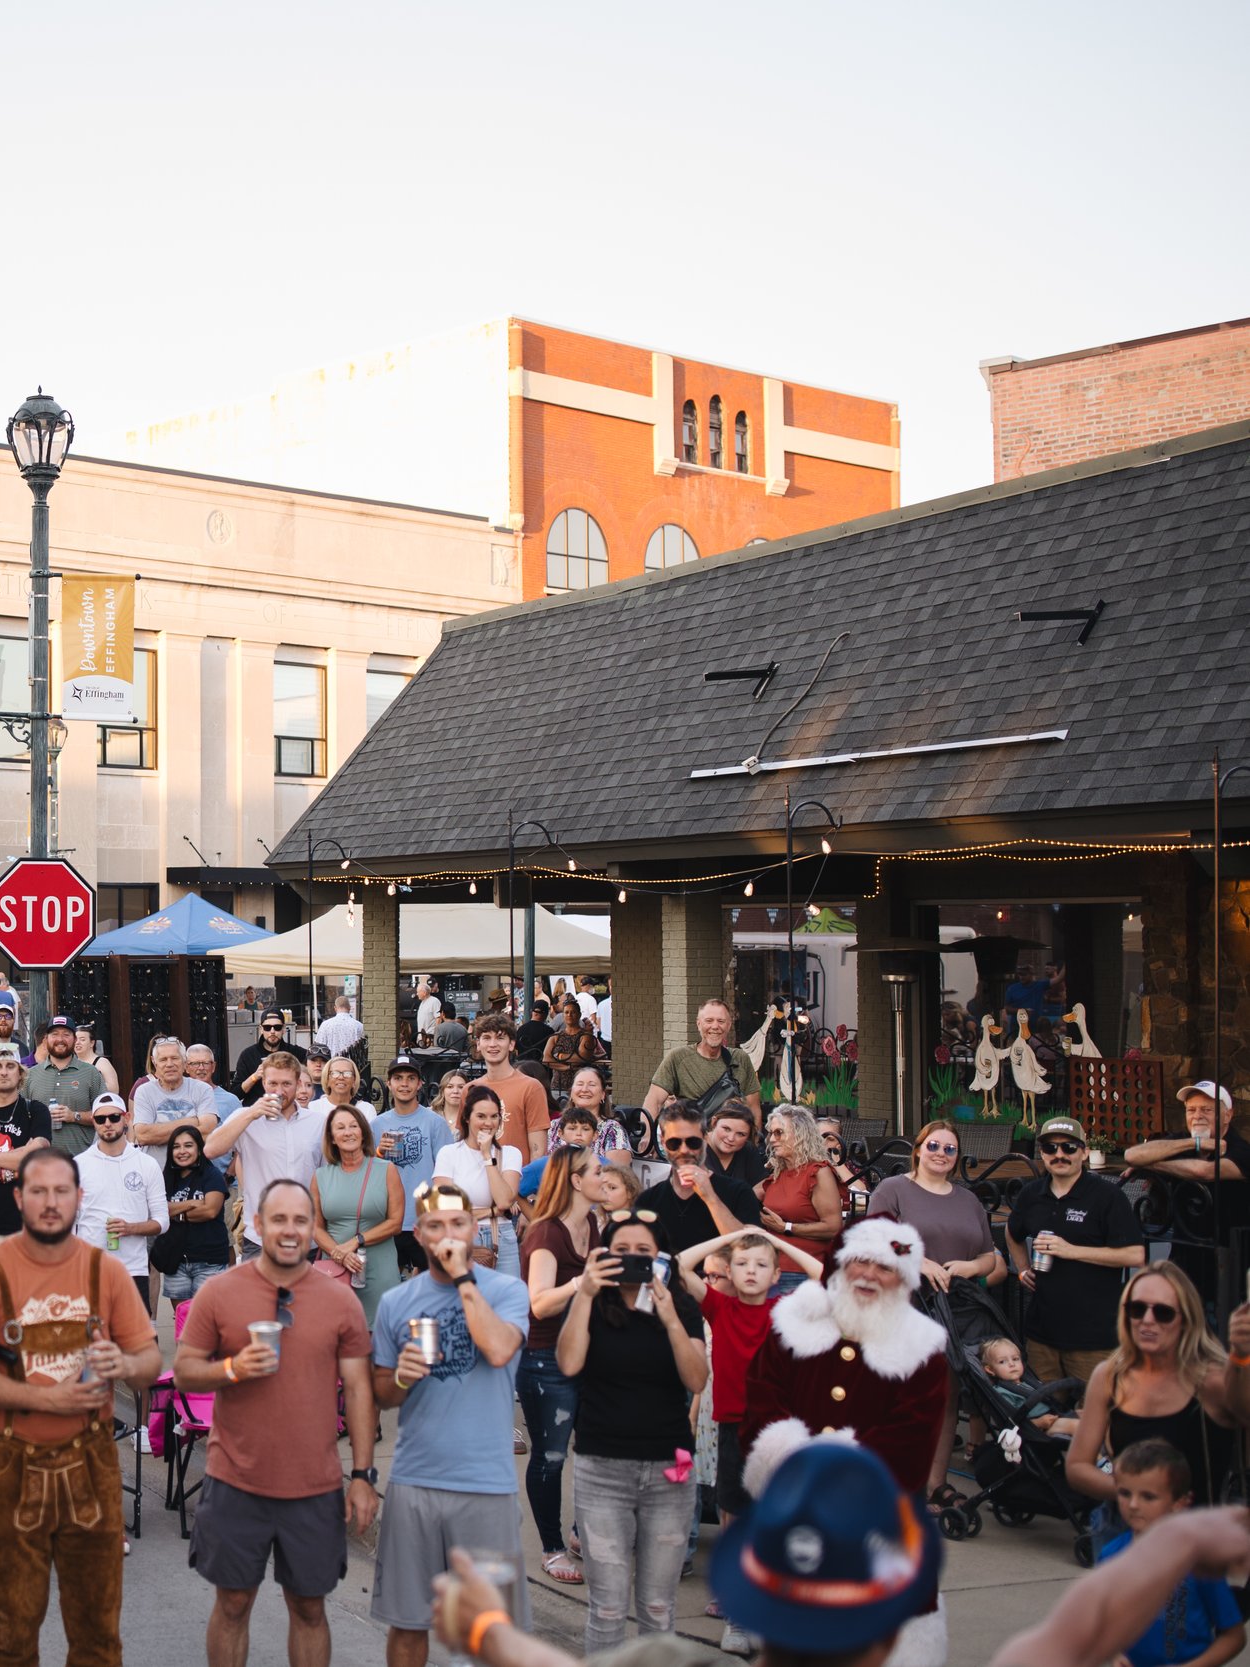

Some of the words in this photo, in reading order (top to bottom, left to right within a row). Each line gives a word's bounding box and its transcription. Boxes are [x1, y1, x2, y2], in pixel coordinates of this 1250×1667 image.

[78, 587, 97, 672] Downtown
[105, 587, 116, 673] EFFINGHAM
[262, 602, 287, 626] OF
[85, 690, 124, 699] Effingham
[0, 895, 85, 933] STOP
